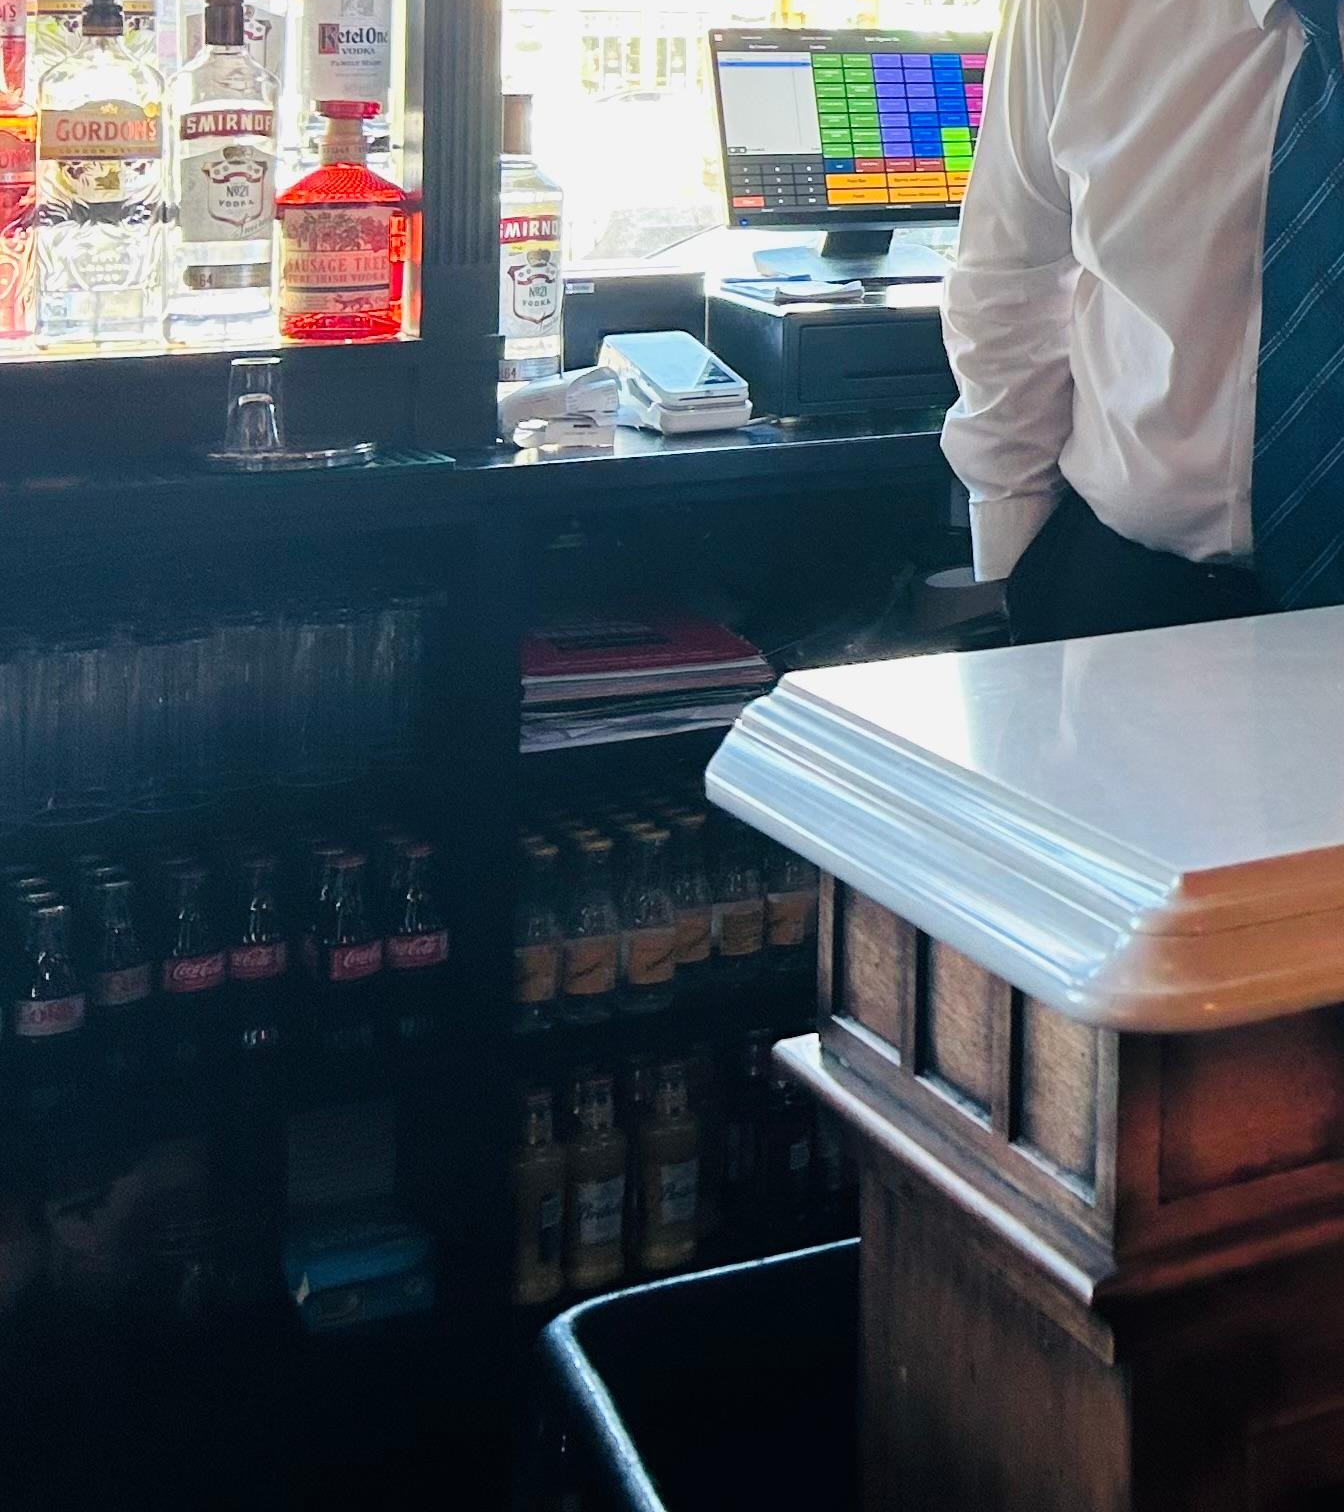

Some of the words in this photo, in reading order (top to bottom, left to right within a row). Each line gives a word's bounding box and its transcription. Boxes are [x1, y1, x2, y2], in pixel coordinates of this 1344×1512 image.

[320, 26, 364, 50] Ketel
[366, 27, 389, 44] One
[341, 47, 376, 55] VODKA
[56, 119, 157, 141] GORDON'S
[286, 257, 347, 273] SAUSAGE
[353, 255, 388, 272] TREE
